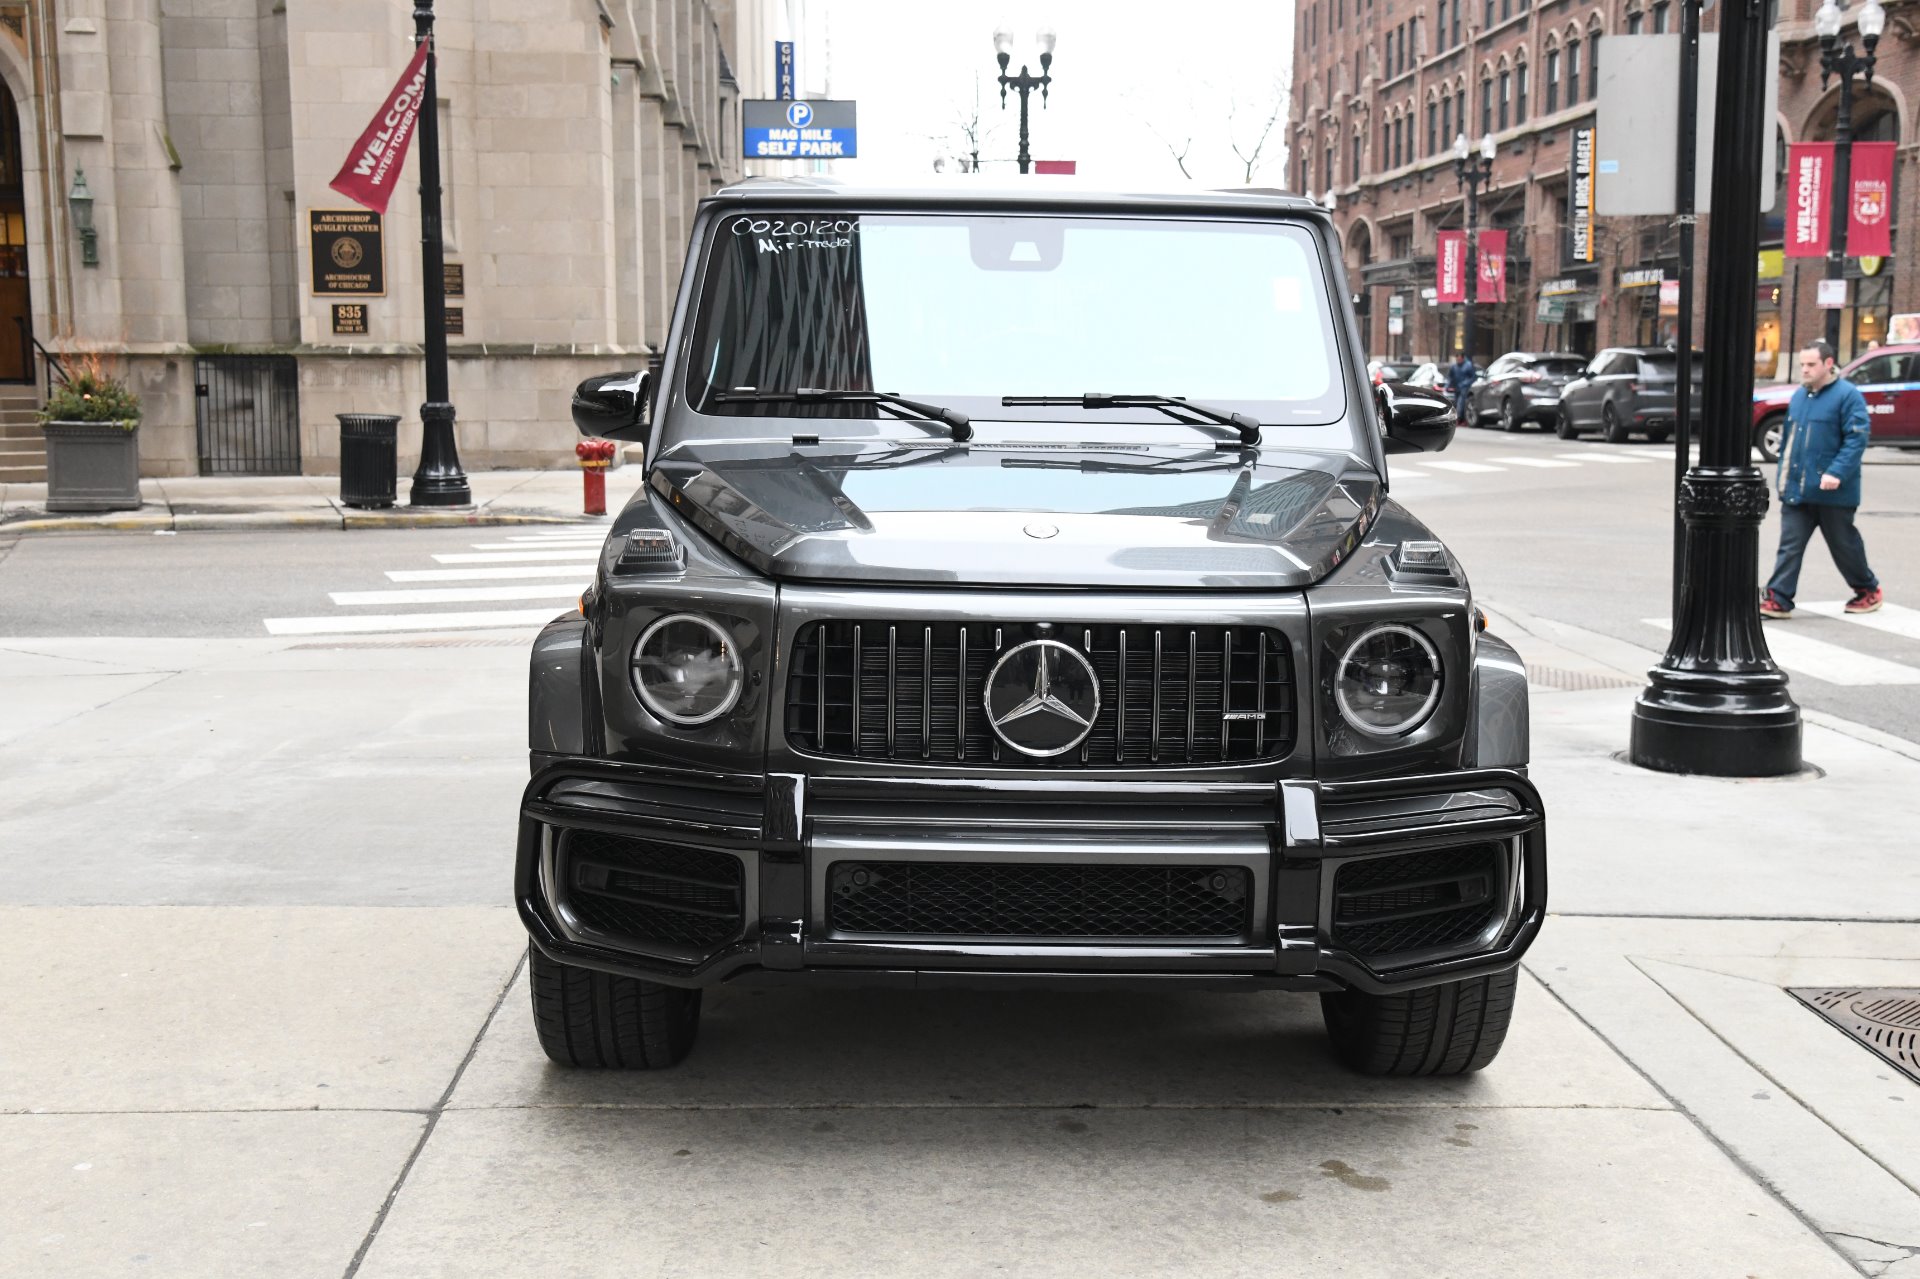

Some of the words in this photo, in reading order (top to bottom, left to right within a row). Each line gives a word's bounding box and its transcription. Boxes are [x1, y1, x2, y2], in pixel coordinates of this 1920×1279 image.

[793, 105, 808, 124] P
[769, 129, 798, 140] MAG
[801, 129, 832, 140] MILE
[371, 148, 396, 185] WATER
[390, 109, 415, 148] TOWER
[757, 141, 797, 155] SELF
[800, 141, 843, 155] PARK
[1577, 129, 1591, 174] BAGELS
[1797, 156, 1814, 243] WELCOME
[313, 224, 348, 232] QUIGLEY
[348, 224, 379, 232] CENTER
[1443, 240, 1453, 294] WELCOME
[338, 306, 361, 319] 835
